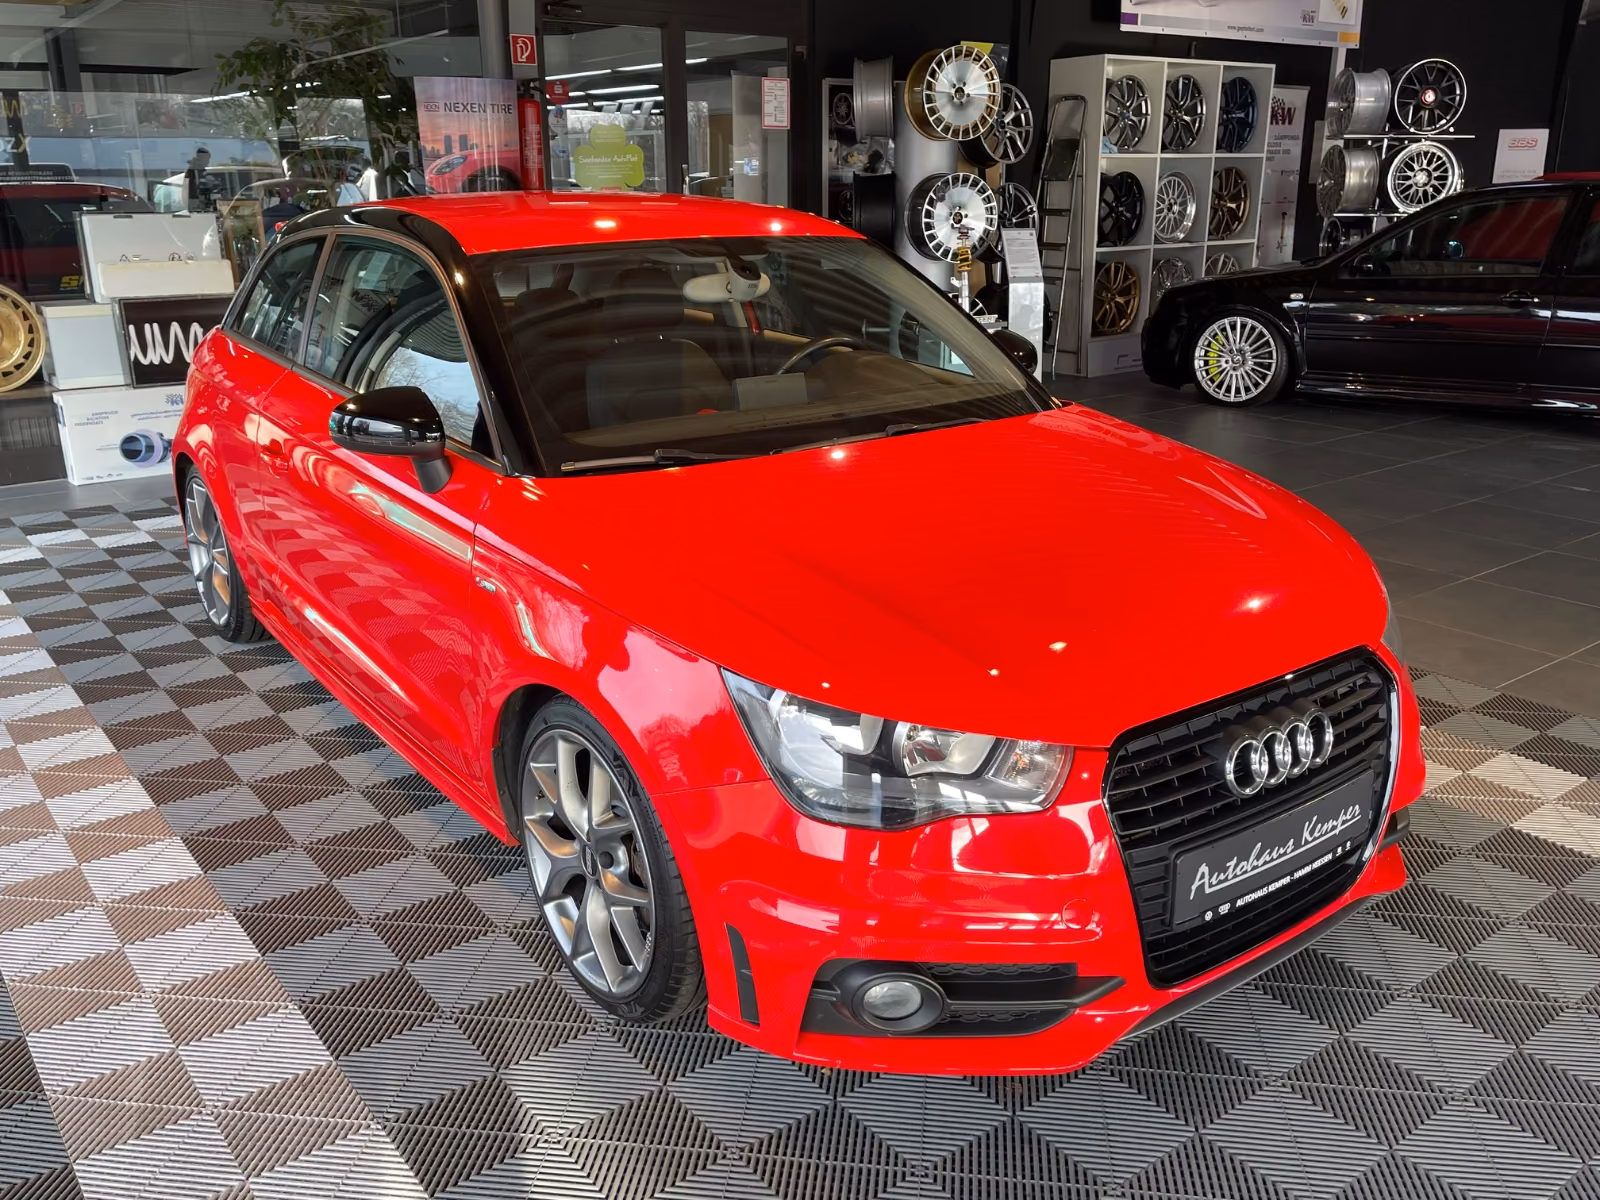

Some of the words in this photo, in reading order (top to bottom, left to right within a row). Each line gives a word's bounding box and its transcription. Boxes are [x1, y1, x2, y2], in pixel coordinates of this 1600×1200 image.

[444, 102, 487, 114] NEXEN
[490, 103, 513, 115] TIRE
[1508, 137, 1538, 149] BBS
[1190, 838, 1295, 900] Autohaus
[1301, 804, 1361, 845] Kemper
[1236, 887, 1268, 907] AUTOHAUS
[1268, 876, 1291, 893] KEMPER
[1293, 865, 1312, 880] HAMM
[1311, 852, 1333, 870] HEESSEN
